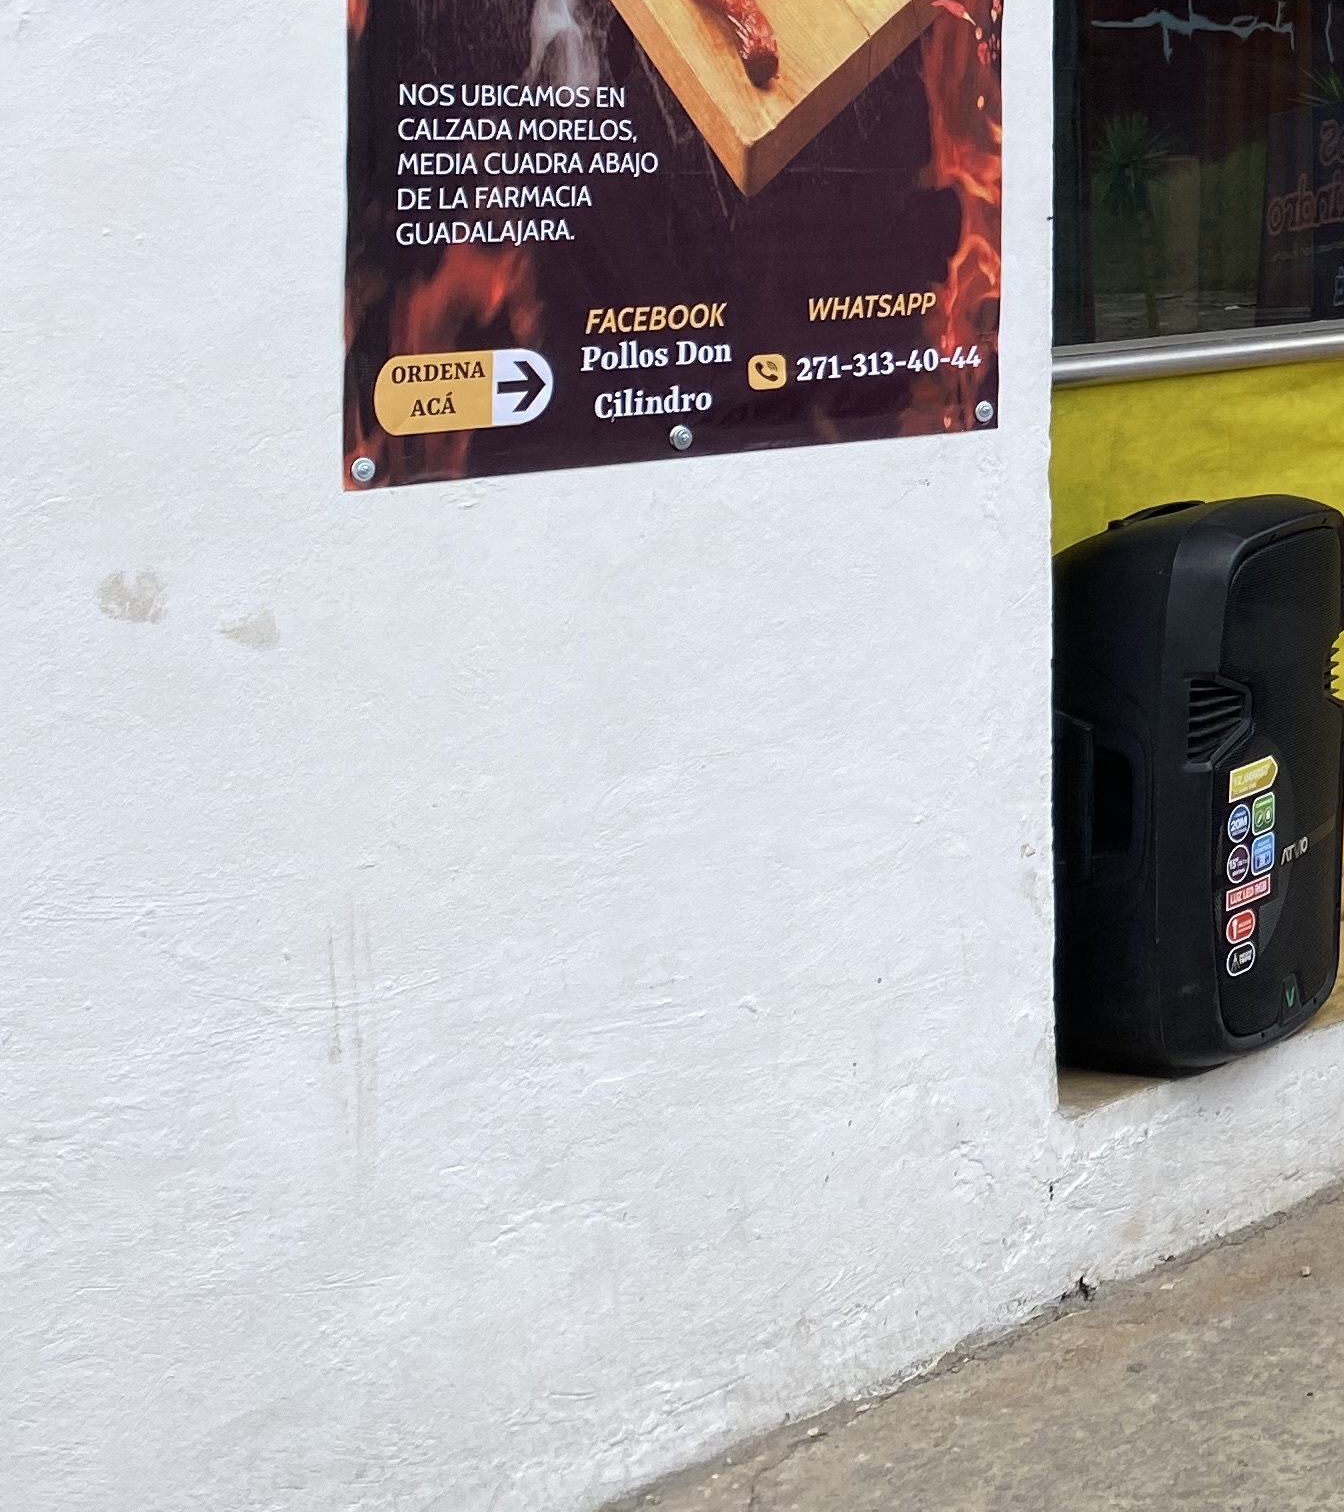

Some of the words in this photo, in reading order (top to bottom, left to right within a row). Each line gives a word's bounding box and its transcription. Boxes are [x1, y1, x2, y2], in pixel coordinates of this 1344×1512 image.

[398, 83, 455, 108] NOS
[461, 84, 590, 109] UBICAMOS
[597, 87, 625, 108] EN
[398, 118, 512, 142] CALZADA
[518, 119, 637, 144] MORELOS,
[397, 152, 478, 176] MEDIA
[484, 152, 583, 175] CUADRA
[589, 152, 659, 178] ABAJO
[397, 187, 431, 210] DE
[439, 187, 468, 209] LA
[475, 186, 592, 209] FARMACIA
[396, 219, 575, 246] GUADALAJARA.
[585, 302, 727, 335] FACEBOOK
[807, 292, 936, 322] WHATSAPP
[581, 342, 668, 372] Pollos
[676, 340, 732, 368] Don
[796, 346, 981, 382] 271-313-40-44
[391, 361, 486, 386] ORDENA
[410, 391, 456, 418] ACÁ
[594, 385, 712, 422] Cilindro
